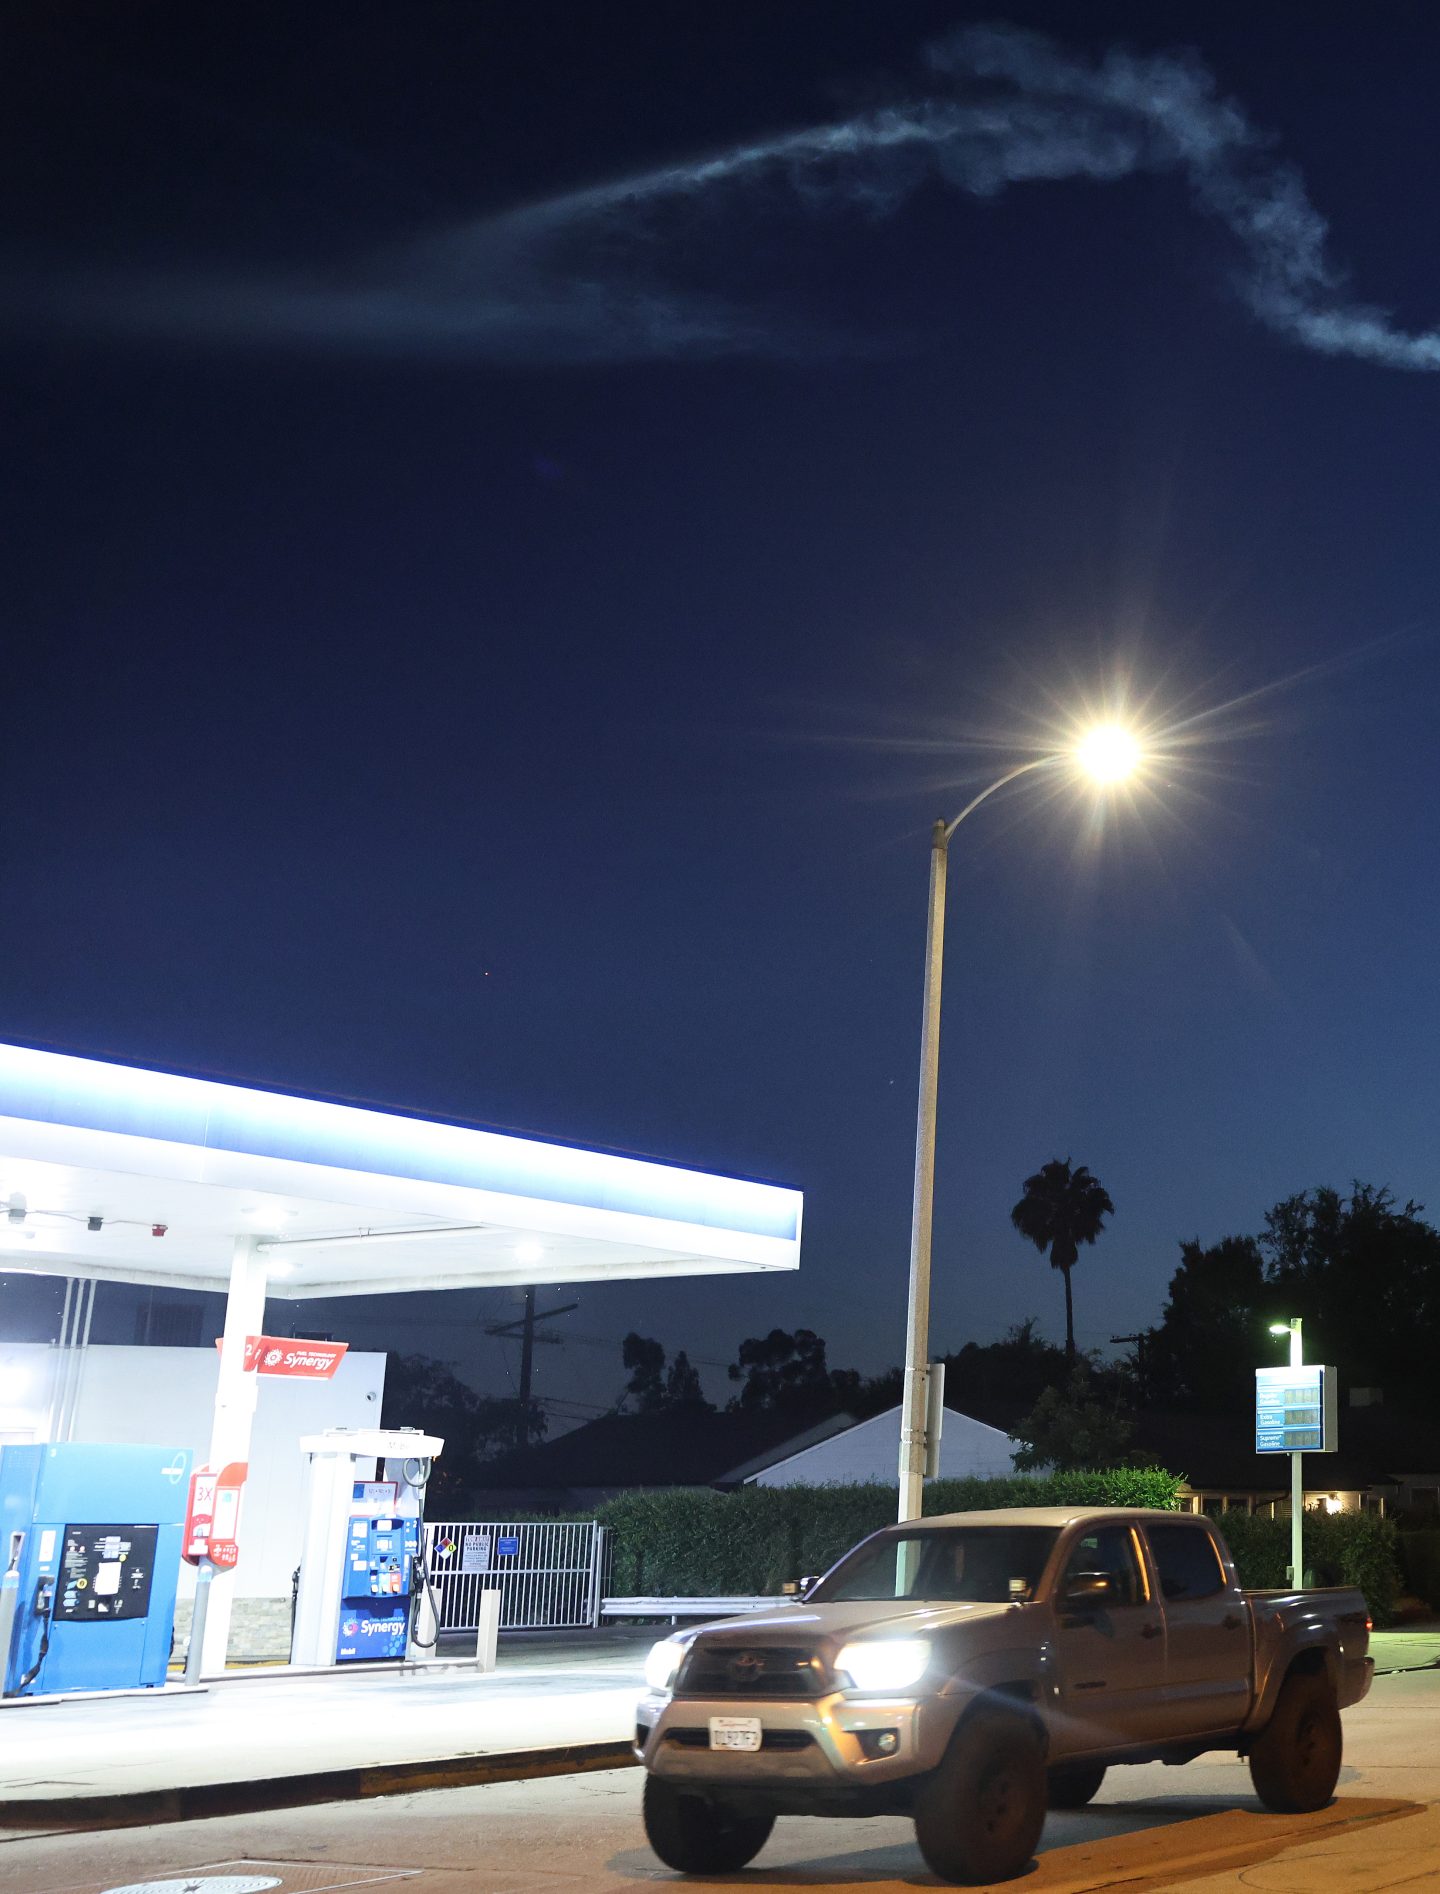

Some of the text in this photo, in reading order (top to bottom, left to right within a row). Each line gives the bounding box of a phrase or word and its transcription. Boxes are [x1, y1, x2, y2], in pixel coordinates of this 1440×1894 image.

[246, 1344, 253, 1356] 2
[284, 1353, 334, 1371] Synergy
[361, 1620, 406, 1637] Synergy
